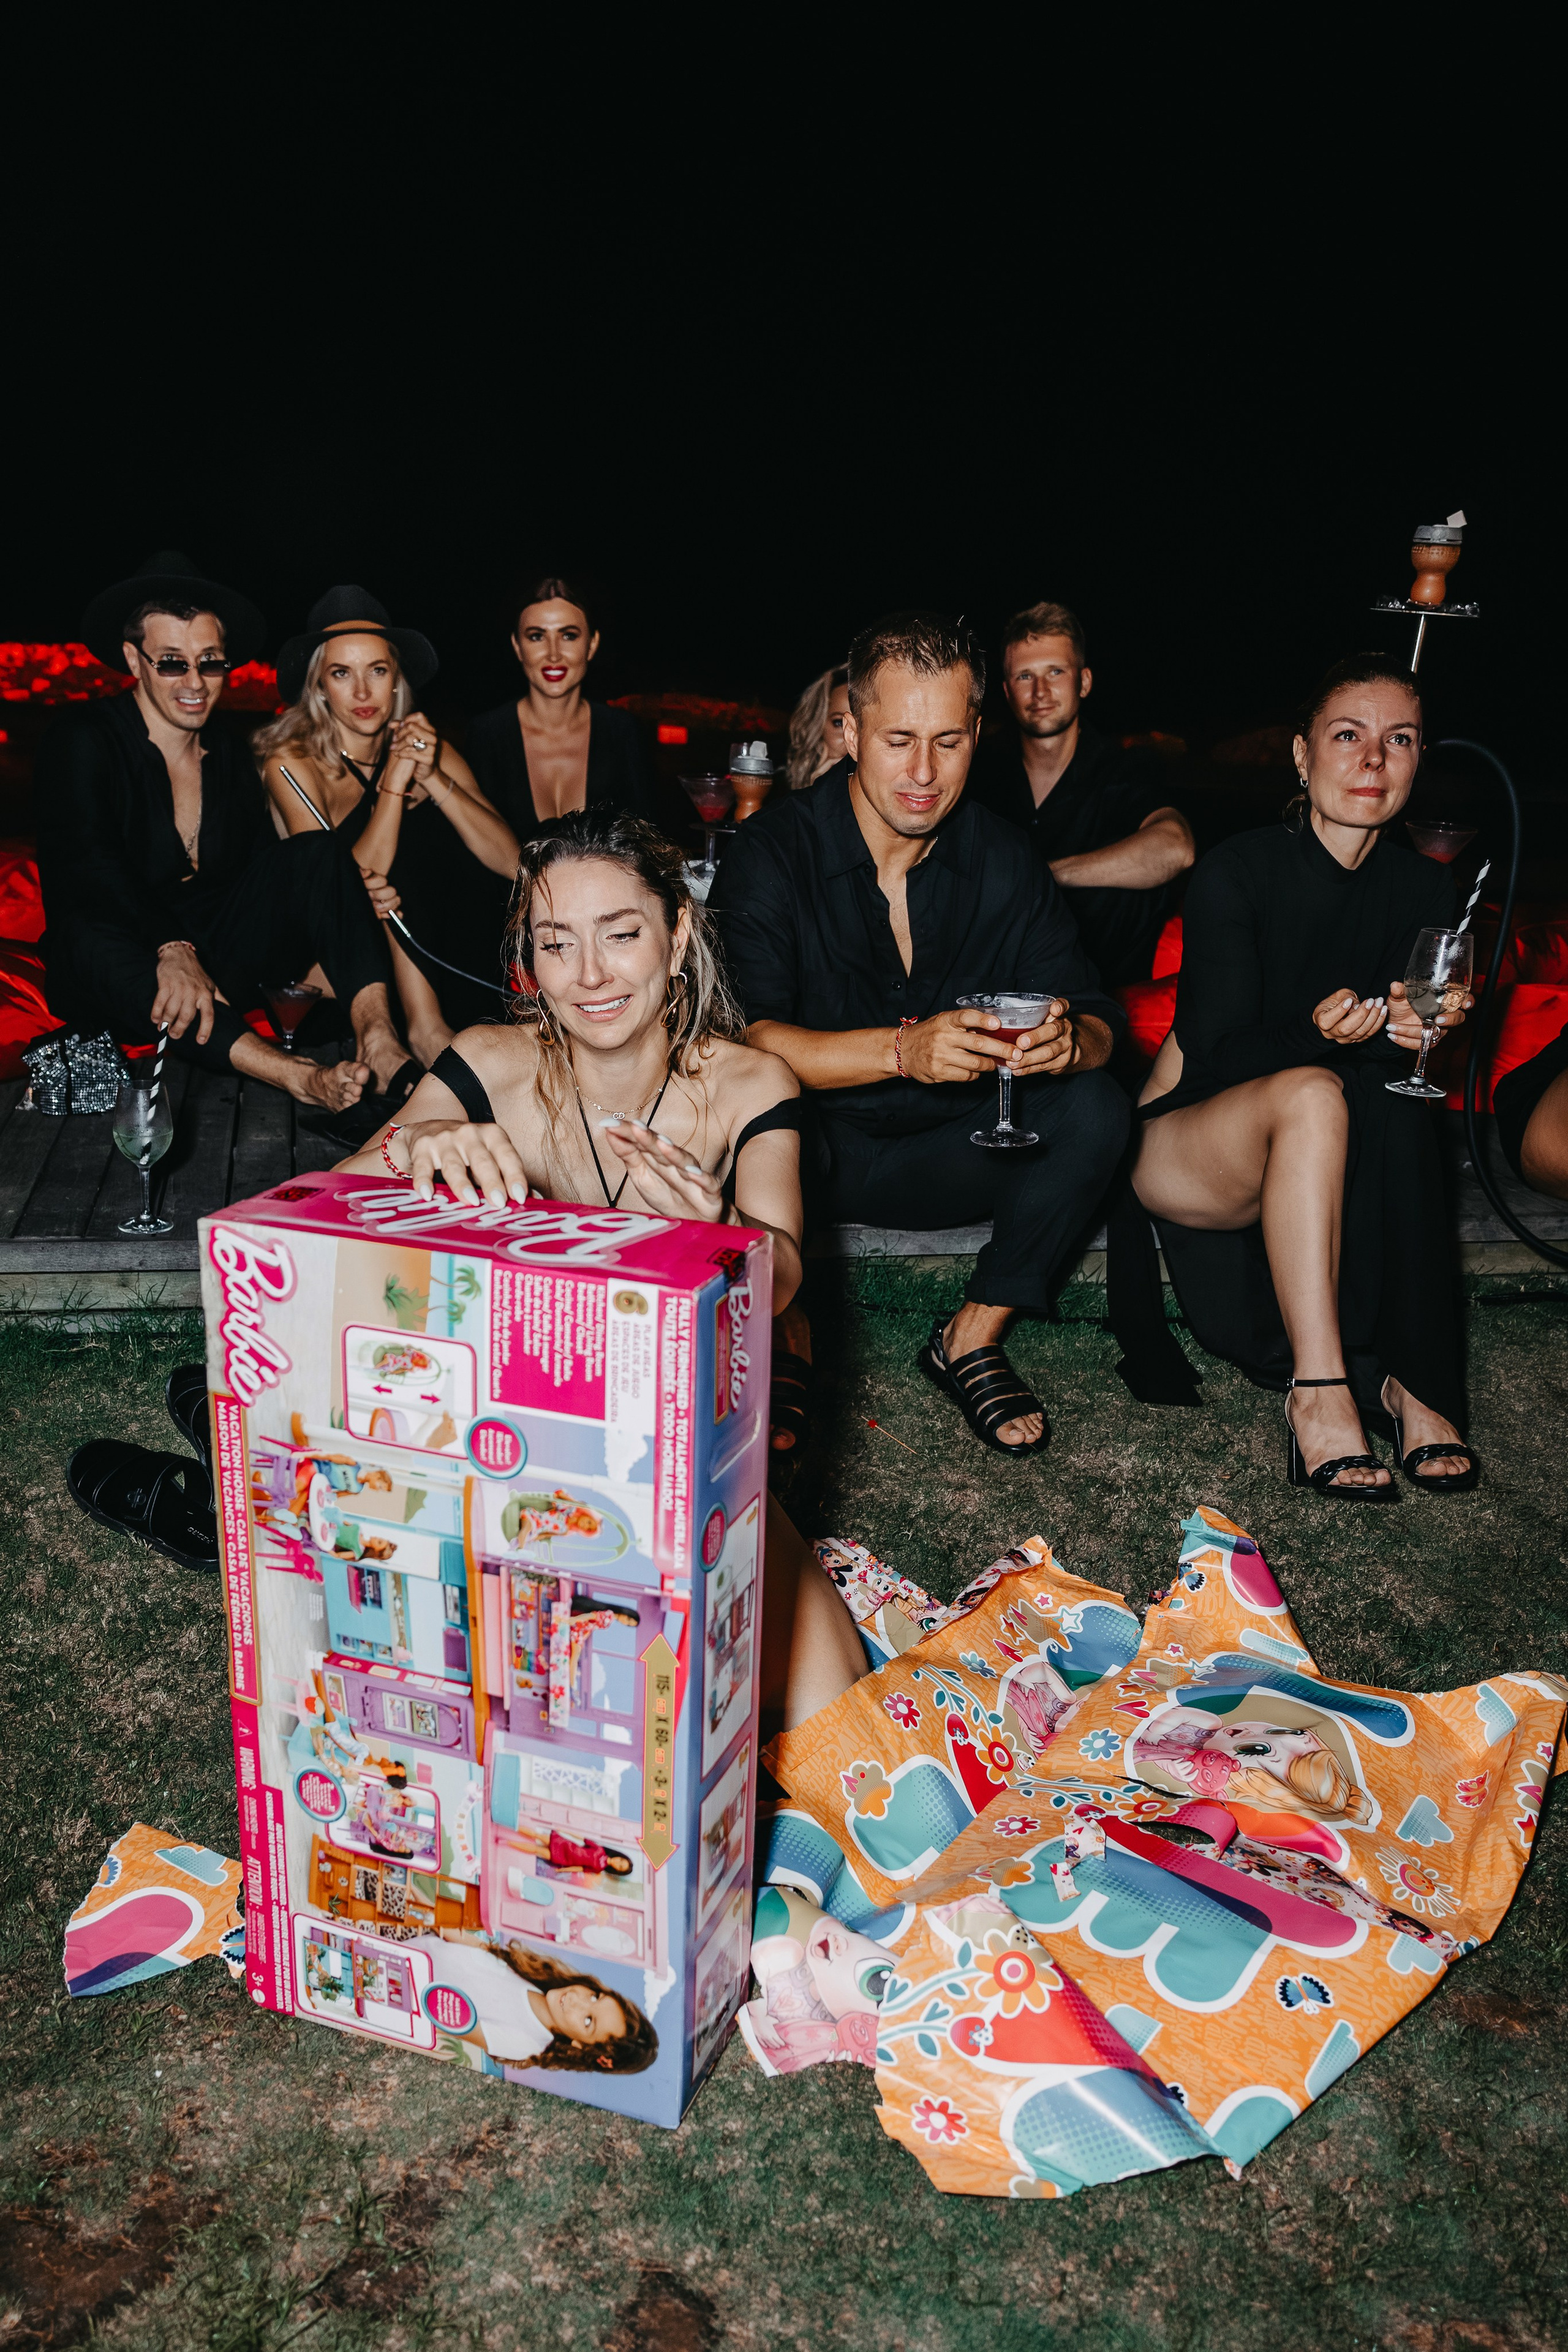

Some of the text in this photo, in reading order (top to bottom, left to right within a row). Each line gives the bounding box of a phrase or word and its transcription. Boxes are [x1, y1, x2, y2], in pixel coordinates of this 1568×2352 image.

[345, 1189, 669, 1264] Barbie
[211, 1227, 298, 1412] Barbie
[613, 1289, 648, 1316] 6
[664, 1295, 677, 1340] TOUTE
[611, 1350, 619, 1362] DE
[632, 1354, 639, 1365] DE
[728, 1278, 753, 1414] Barbie
[621, 1362, 628, 1373] DE
[663, 1340, 679, 1394] ÉQUIPÉE
[217, 1401, 230, 1447] MAISON
[662, 1401, 675, 1438] TODO
[673, 1297, 691, 1570] FULLY FURNISHED TOTALMENTE AMUEBLADA
[220, 1447, 231, 1469] DE
[222, 1469, 235, 1533] VACANCES
[229, 1404, 252, 1646] VACATION HOUSE CASA DE VACACIONES
[226, 1541, 237, 1575] CASA
[228, 1575, 238, 1591] DE
[232, 1632, 242, 1649] DA
[233, 1650, 244, 1691] BARBIE
[655, 1714, 669, 1725] X
[239, 1746, 256, 1792] WARNING:
[653, 1798, 667, 1808] X
[251, 1971, 264, 1988] 3+
